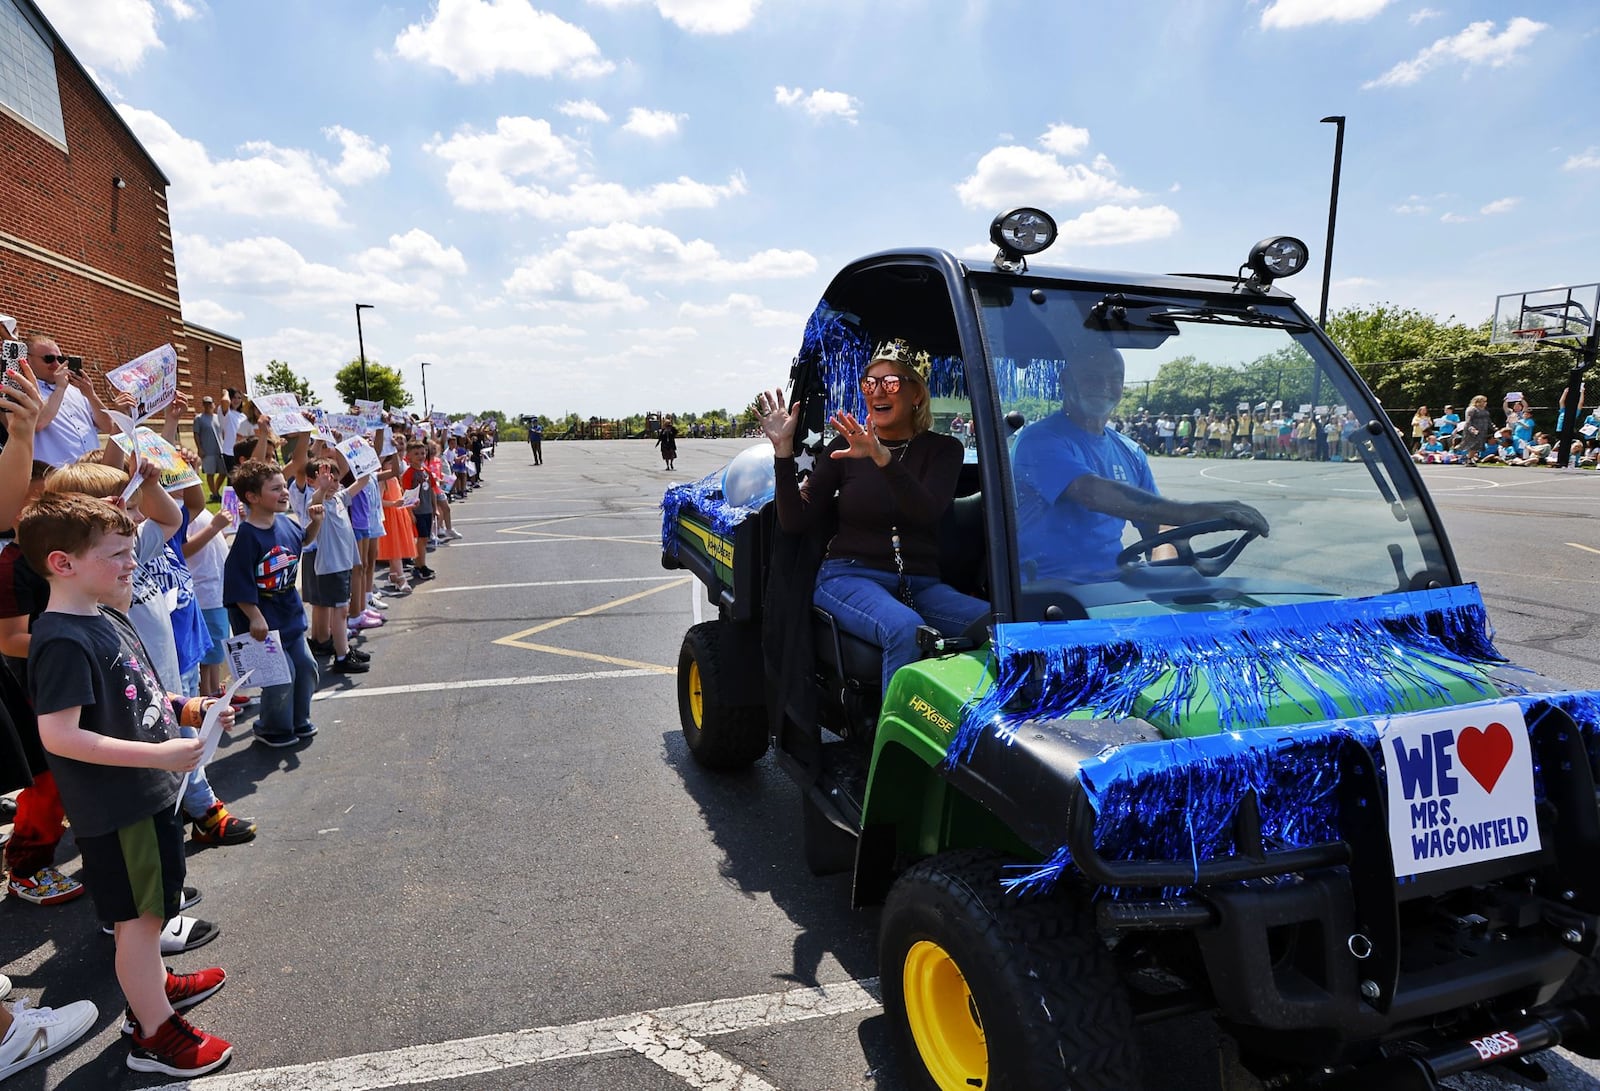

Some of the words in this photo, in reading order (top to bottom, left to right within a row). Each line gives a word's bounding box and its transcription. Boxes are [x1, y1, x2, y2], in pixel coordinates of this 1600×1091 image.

[908, 696, 954, 733] HPX615E
[1392, 729, 1459, 800] WE
[1410, 798, 1458, 829] MRS.
[1411, 816, 1529, 860] WAGONFIELD
[1470, 1031, 1519, 1059] BOSS
